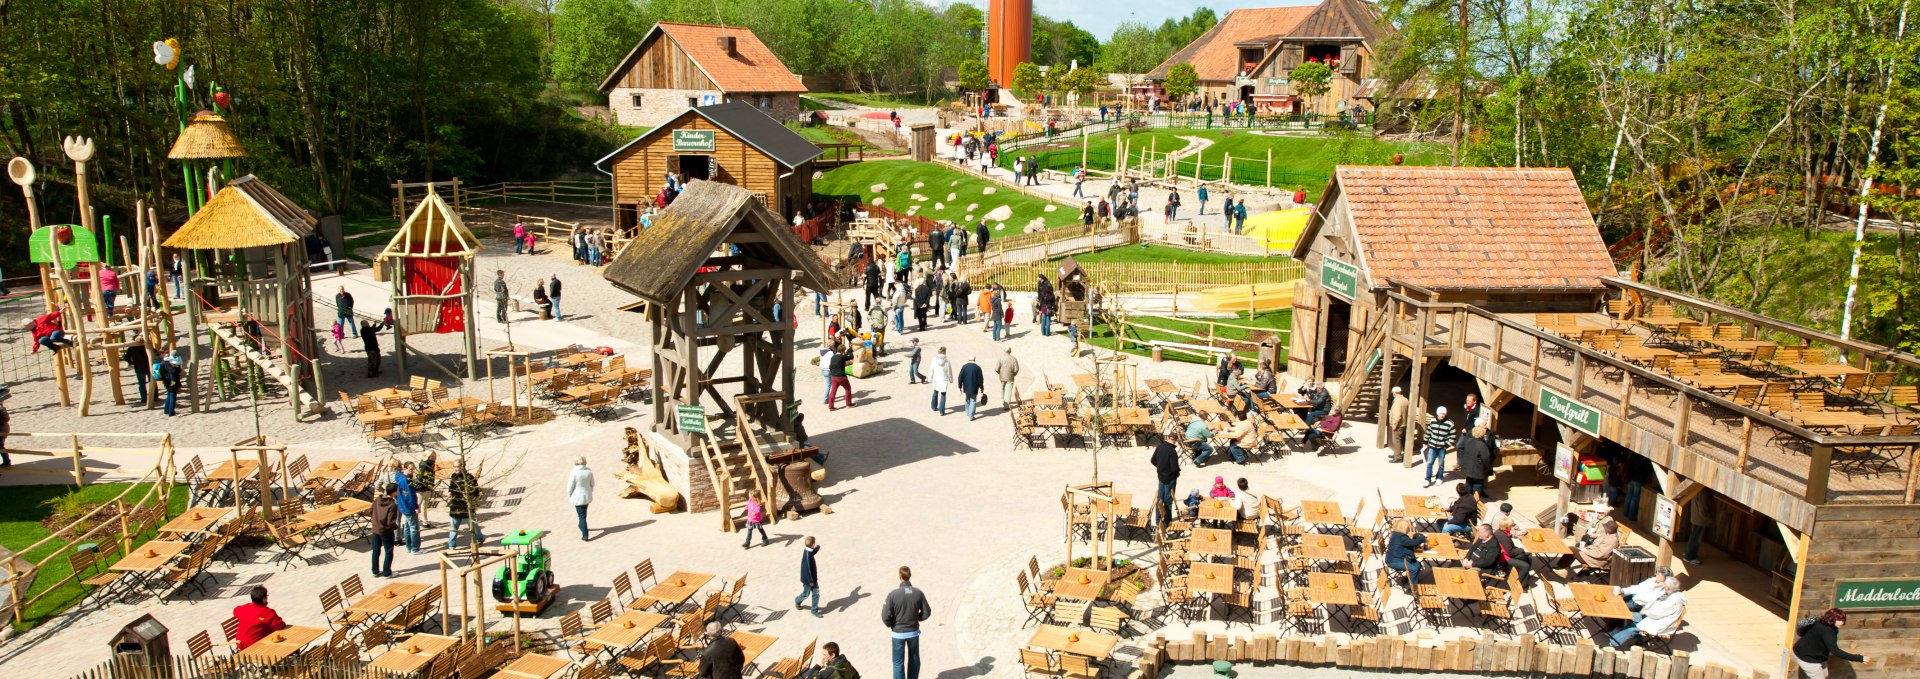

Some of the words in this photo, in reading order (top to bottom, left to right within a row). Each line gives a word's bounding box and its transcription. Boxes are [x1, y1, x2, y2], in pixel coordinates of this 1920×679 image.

[680, 131, 707, 139] Kinder-
[675, 139, 713, 149] Bauernhof
[37, 242, 93, 261] Krls
[1549, 396, 1590, 424] Dorfgrill
